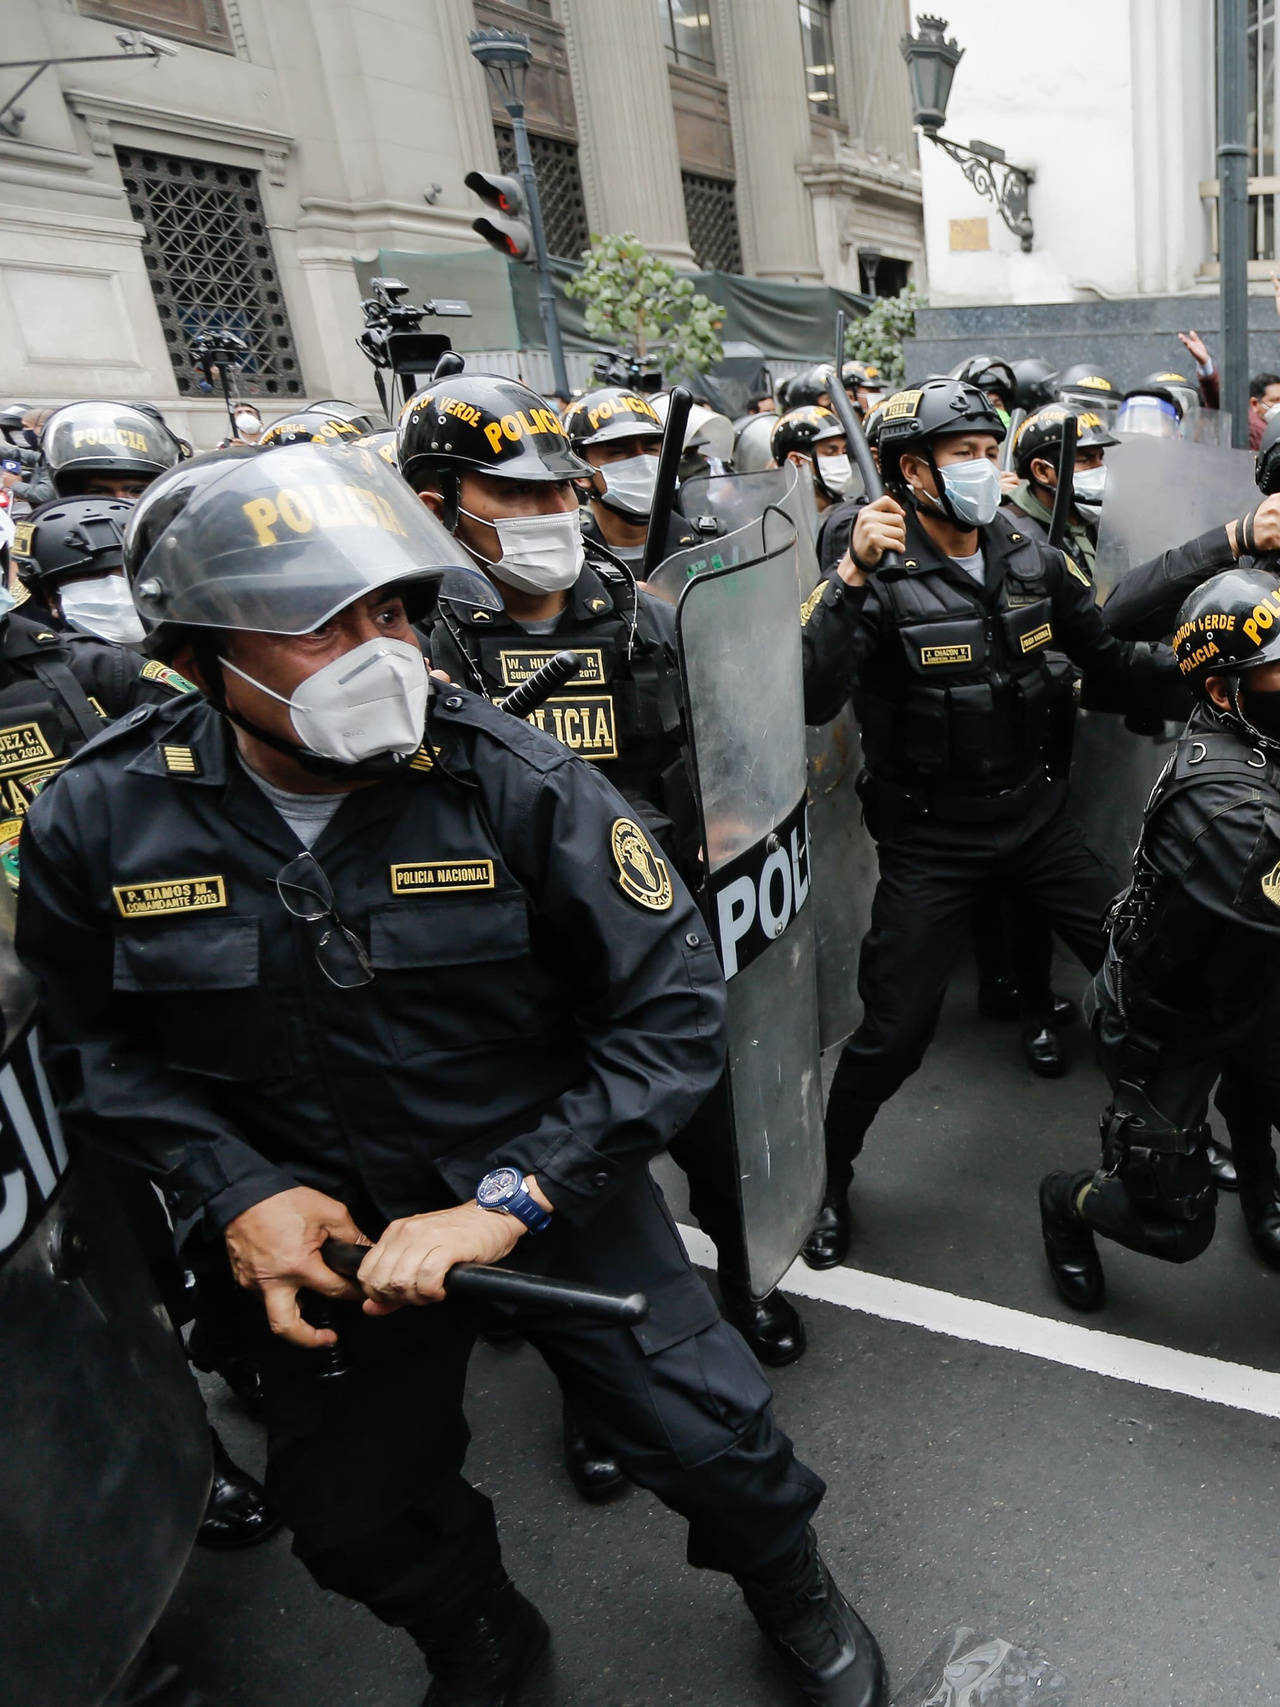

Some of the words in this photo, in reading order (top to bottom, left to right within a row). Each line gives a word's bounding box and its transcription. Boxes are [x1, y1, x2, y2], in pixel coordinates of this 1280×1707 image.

[439, 396, 482, 428] VERDE
[72, 427, 148, 452] POLICIA
[507, 658, 524, 670] W.
[587, 657, 598, 667] R.
[1179, 641, 1220, 676] POLICIA
[579, 670, 597, 678] 2017
[23, 730, 39, 745] C.
[526, 708, 612, 748] LICIA
[20, 744, 44, 759] 2020
[397, 869, 434, 885] POLICIA
[437, 867, 489, 883] NACIONAL
[127, 891, 141, 901] P.
[143, 884, 191, 901] RAMOS
[195, 882, 212, 895] M.
[126, 896, 191, 912] COMANDANTE
[193, 893, 218, 905] 2013
